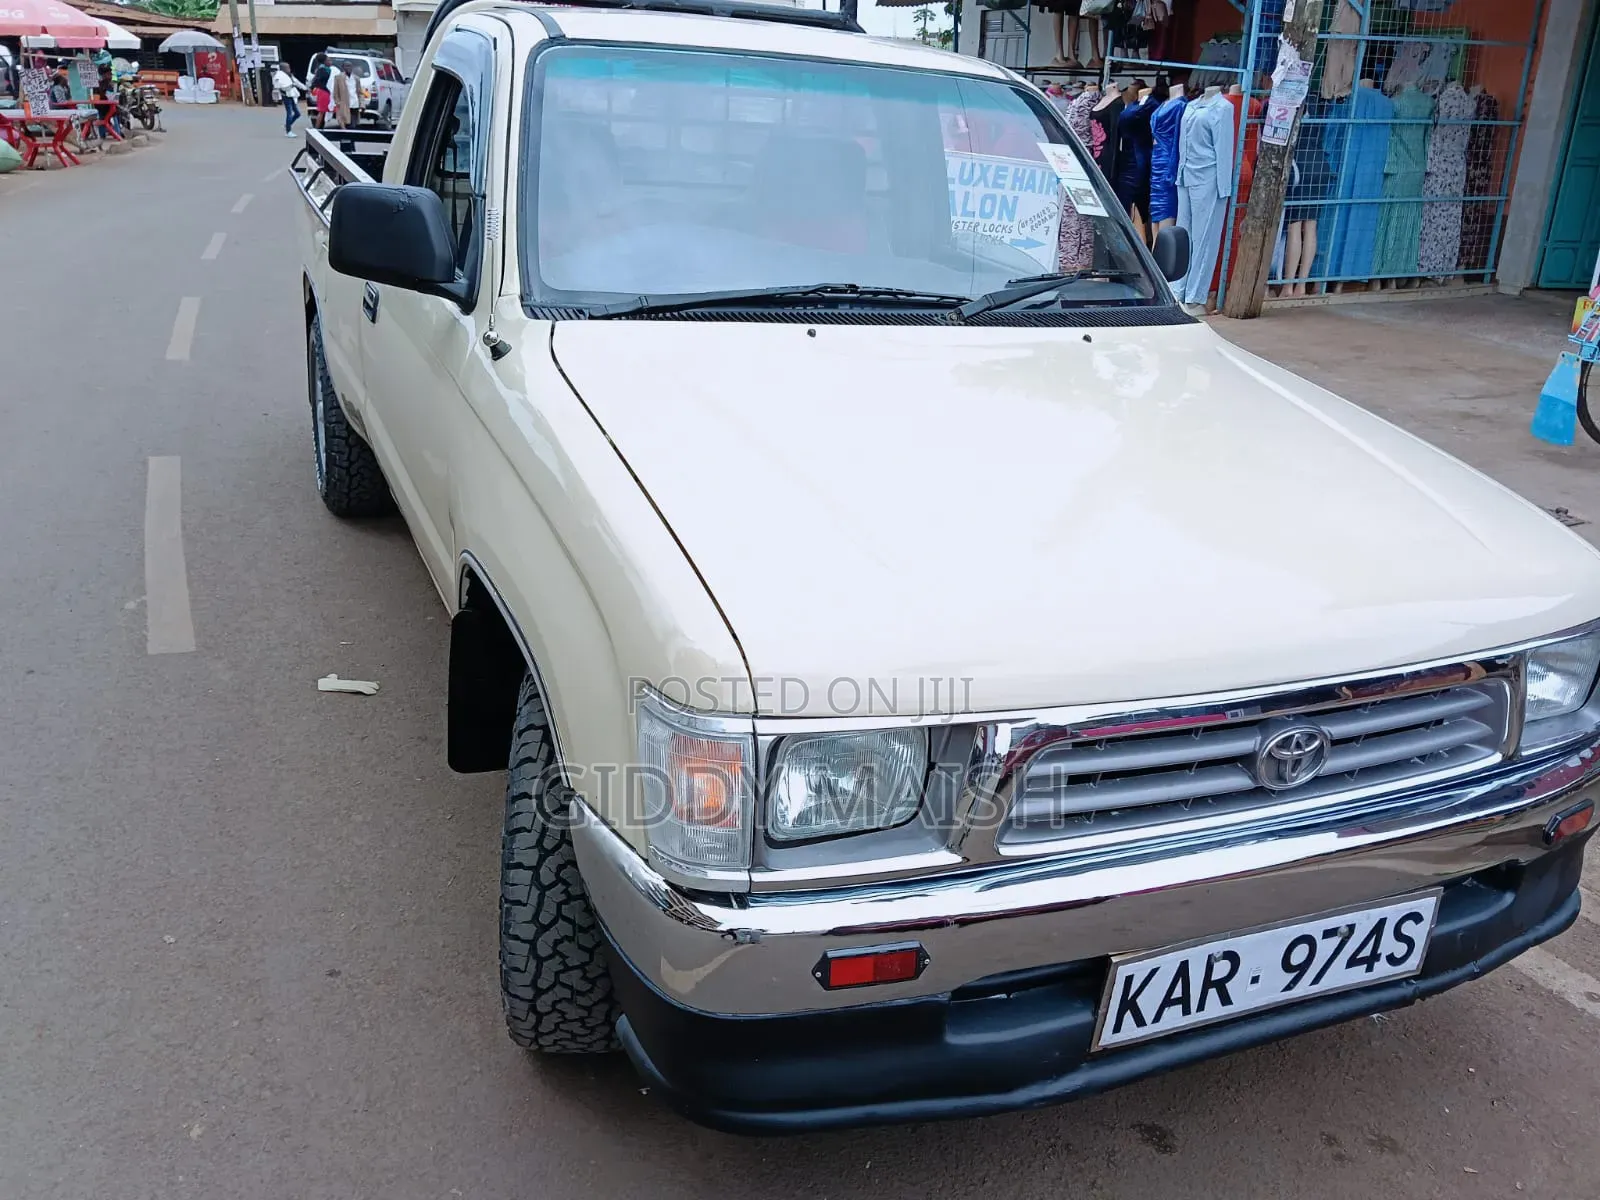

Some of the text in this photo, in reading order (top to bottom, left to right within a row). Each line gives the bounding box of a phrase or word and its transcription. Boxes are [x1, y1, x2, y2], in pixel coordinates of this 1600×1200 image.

[982, 223, 1014, 234] LOCKS
[1111, 911, 1425, 1035] KAR 974S
